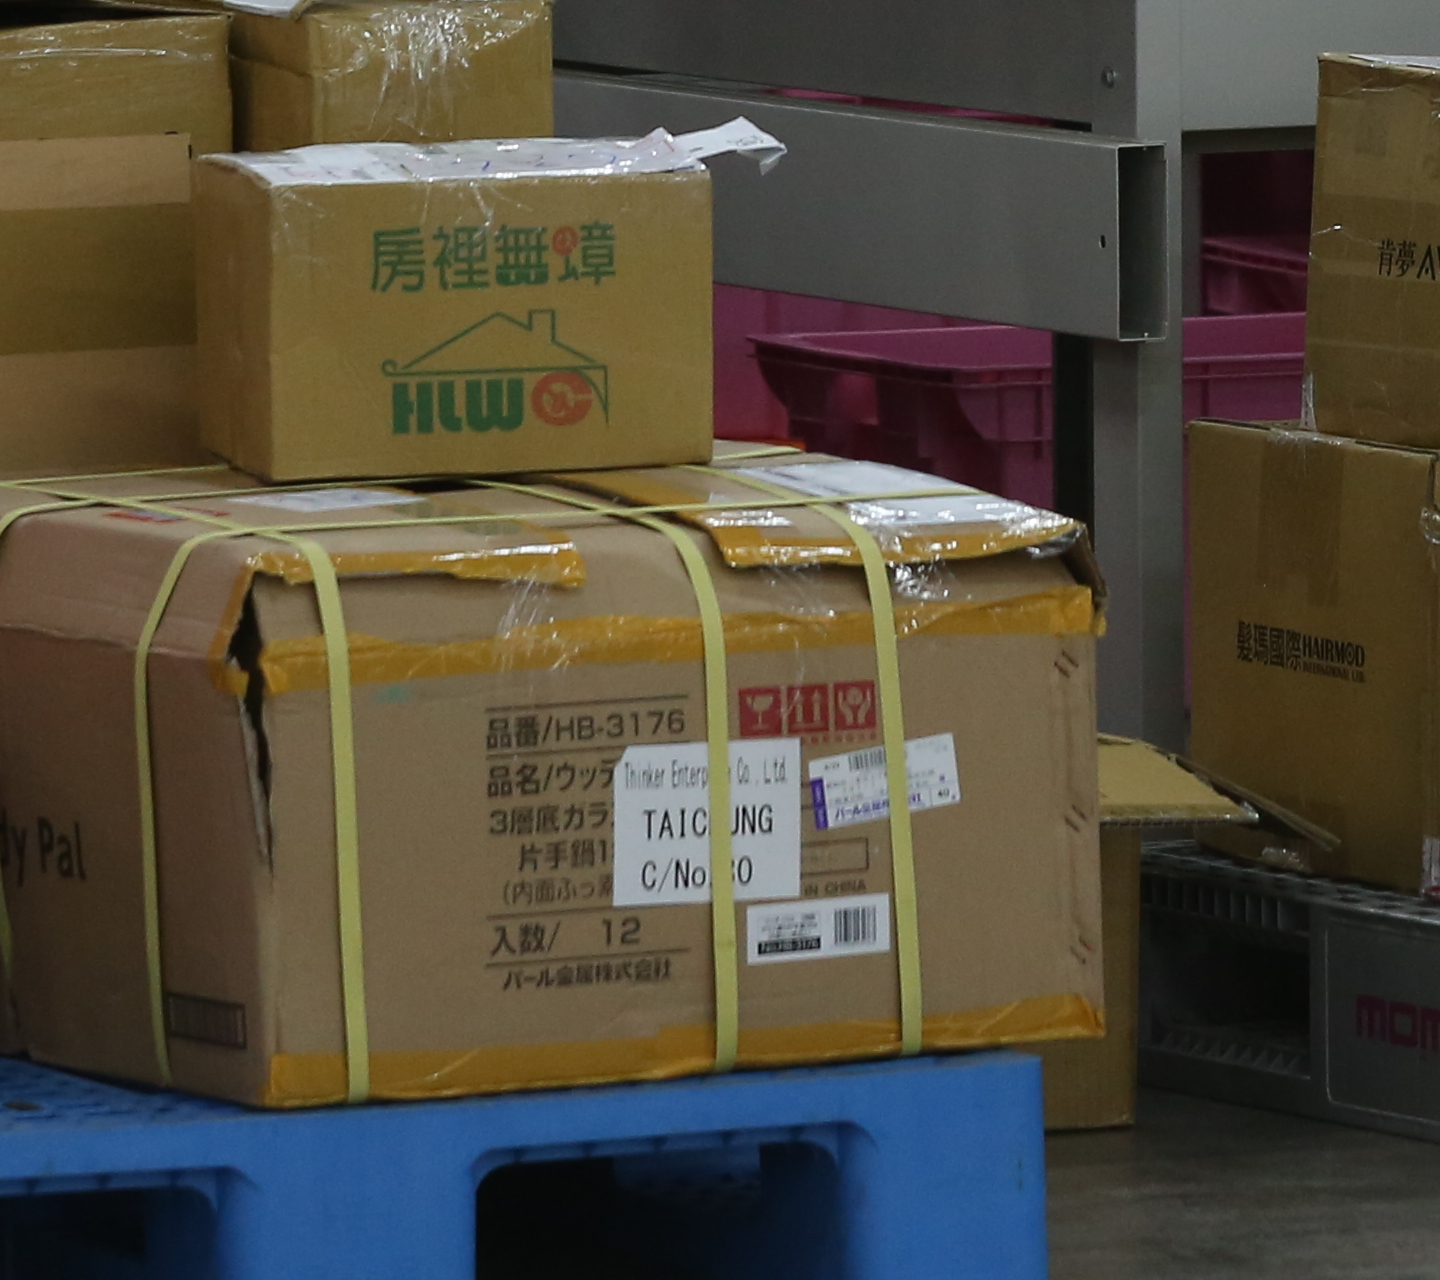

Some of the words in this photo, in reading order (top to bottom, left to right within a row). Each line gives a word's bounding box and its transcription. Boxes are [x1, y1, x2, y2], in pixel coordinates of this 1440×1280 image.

[643, 804, 774, 841] TAICUNG
[37, 816, 87, 881] Pal
[601, 916, 642, 947] 12
